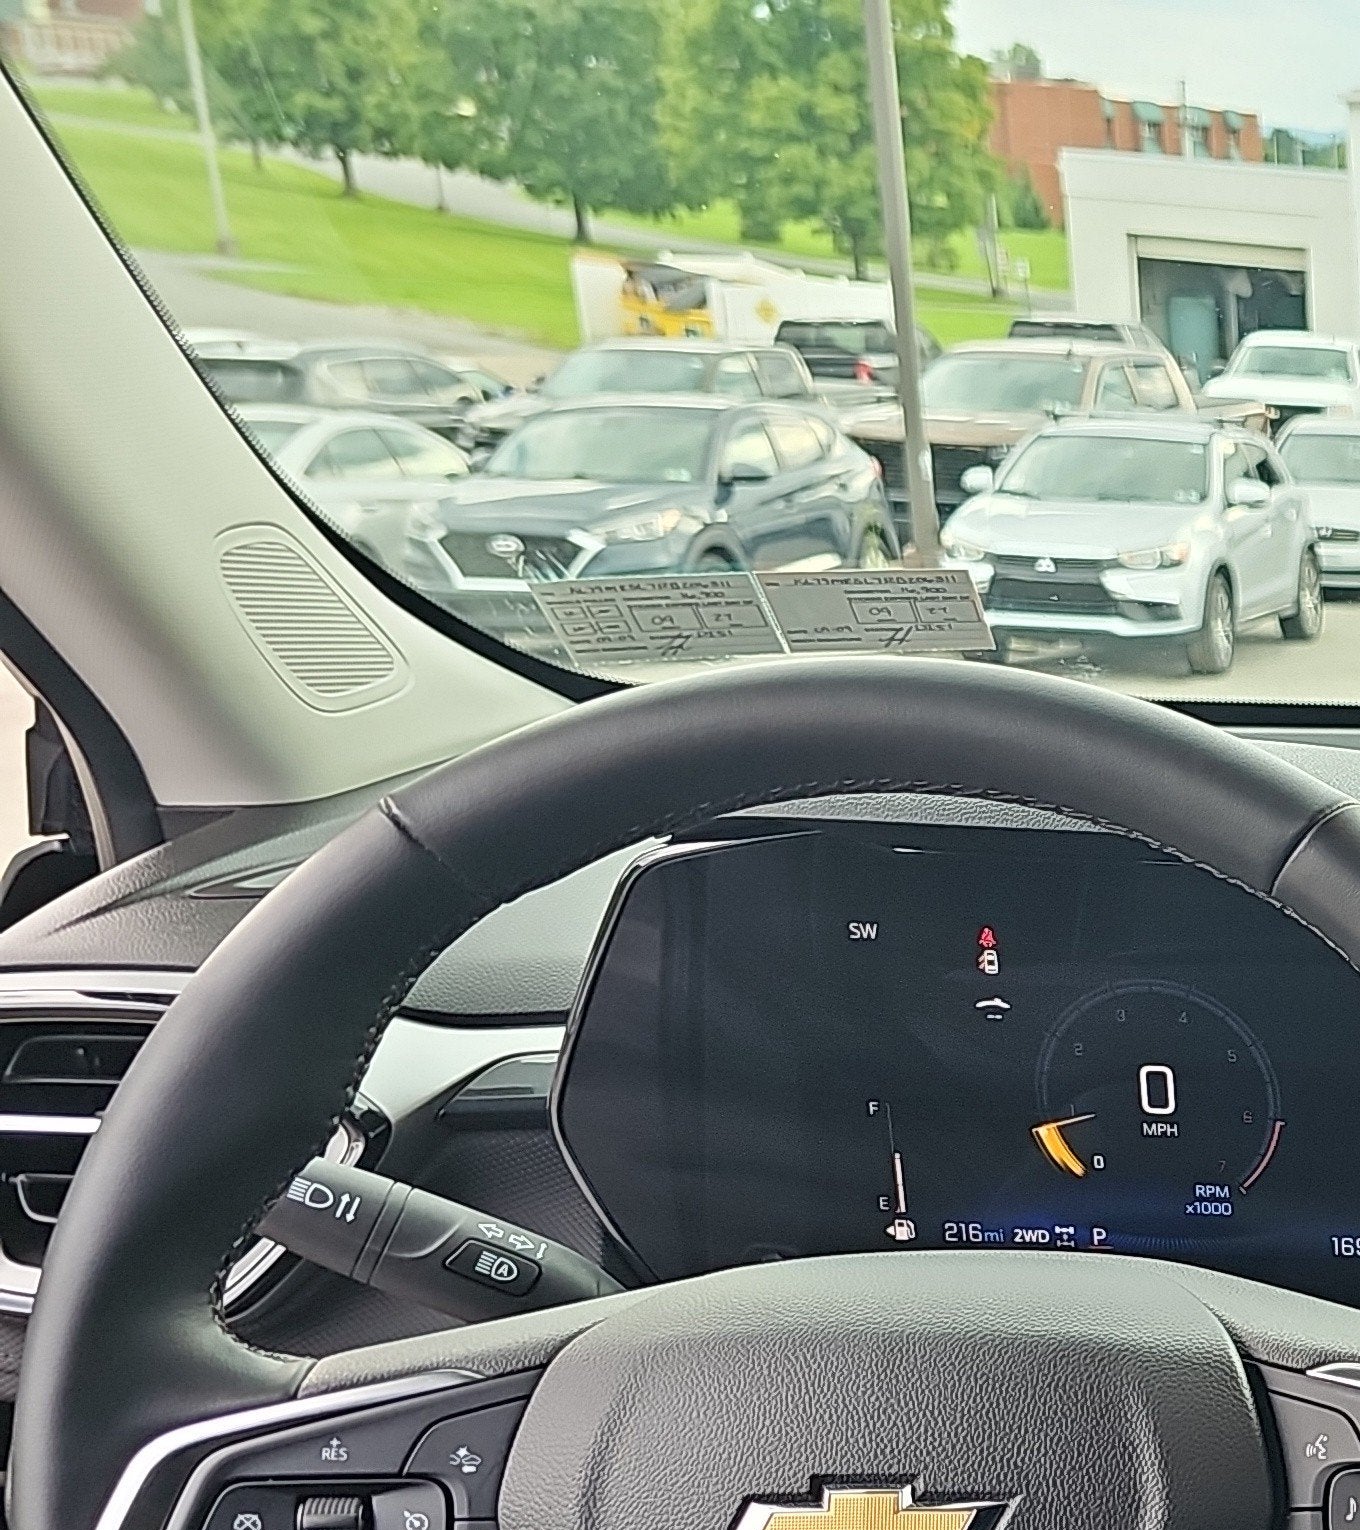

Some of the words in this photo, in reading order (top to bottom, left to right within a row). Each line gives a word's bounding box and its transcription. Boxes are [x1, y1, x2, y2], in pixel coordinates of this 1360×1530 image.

[849, 922, 878, 940] SW
[1178, 1012, 1188, 1023] 4
[1139, 1065, 1176, 1115] 0
[868, 1101, 879, 1115] F
[1143, 1122, 1178, 1137] MPH
[1195, 1184, 1230, 1198] RPM
[879, 1197, 890, 1210] E
[1185, 1202, 1232, 1216] x1000
[1013, 1229, 1050, 1243] 2WD
[1093, 1227, 1107, 1246] P
[321, 1447, 349, 1462] RES
